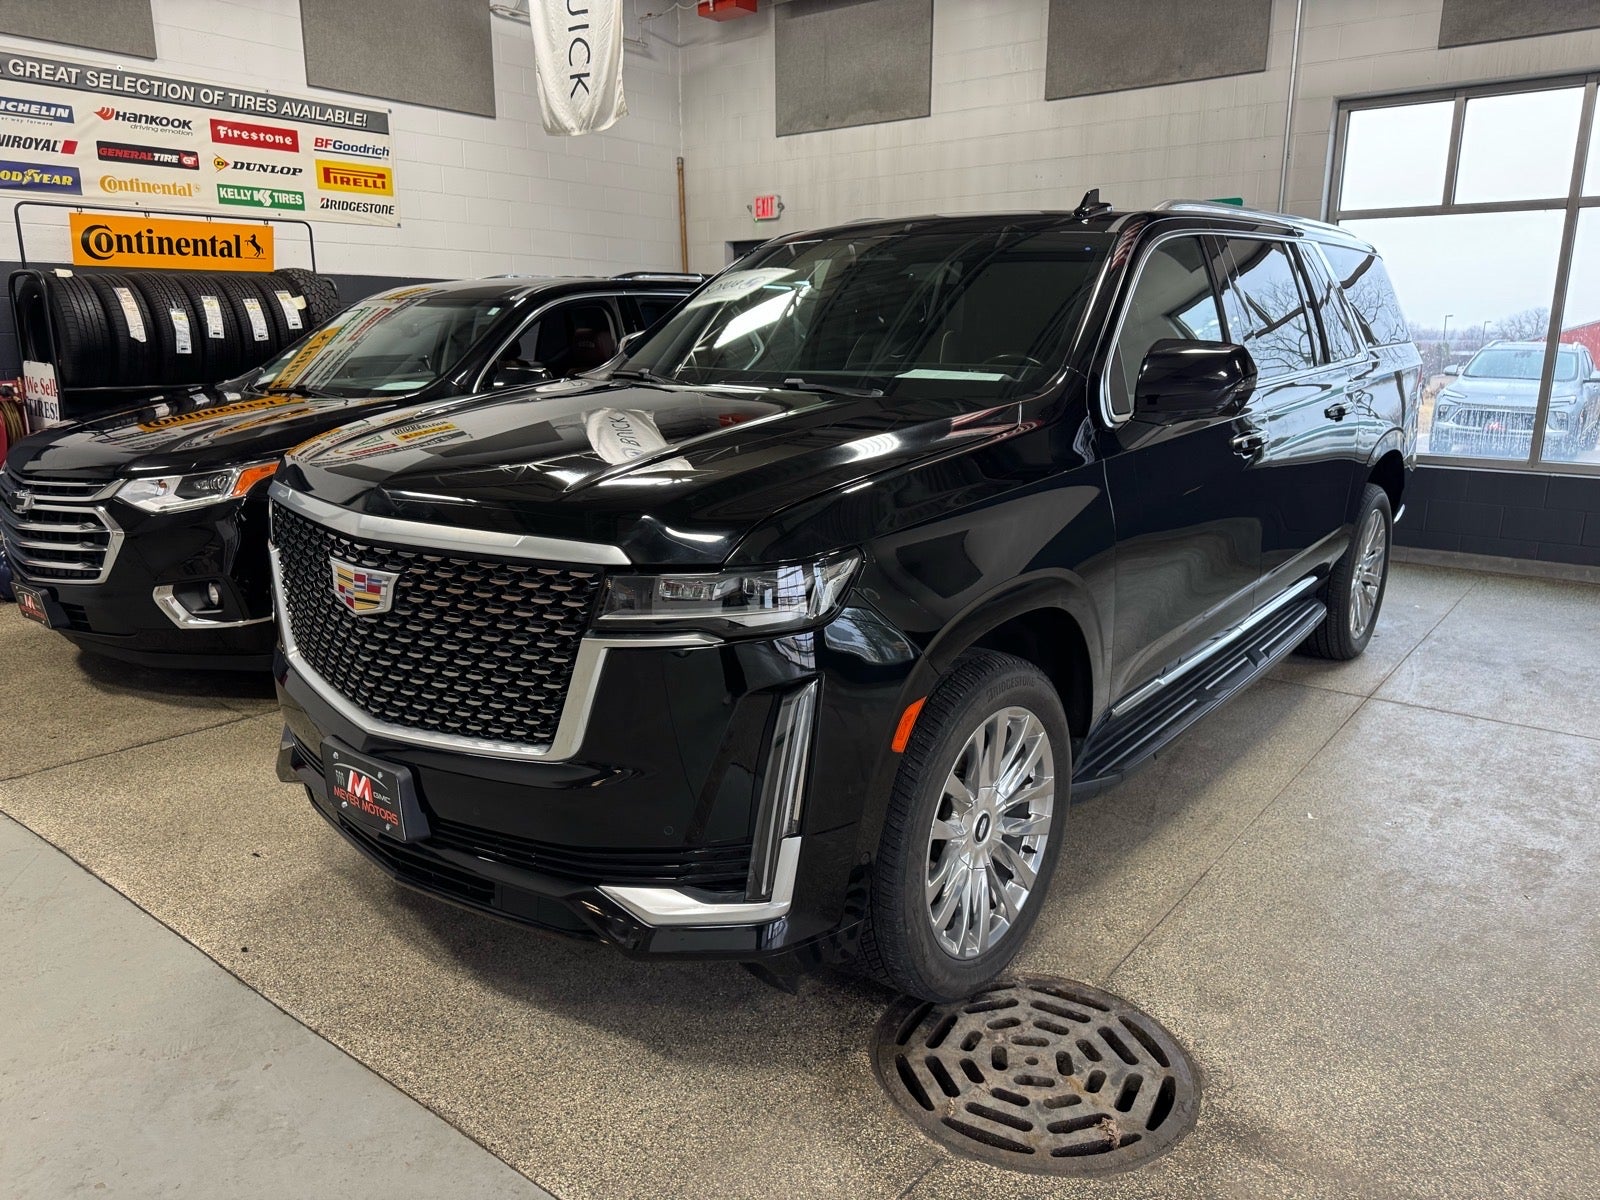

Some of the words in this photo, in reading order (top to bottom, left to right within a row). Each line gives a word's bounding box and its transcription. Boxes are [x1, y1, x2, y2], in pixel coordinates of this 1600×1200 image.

[8, 59, 81, 84] GREAT
[86, 70, 195, 101] SELECTION
[200, 88, 225, 105] OF
[228, 92, 277, 114] TIRES
[281, 101, 367, 127] AVAILABLE!
[130, 123, 159, 133] driving
[160, 128, 193, 137] emotion
[217, 125, 293, 145] Firestone
[314, 137, 390, 157] BFGoodrich
[231, 160, 303, 176] DUNLOP
[99, 174, 193, 197] Continental
[323, 167, 386, 190] PIRELLI
[219, 187, 252, 201] KELLY
[273, 191, 303, 205] TIRES
[320, 197, 395, 216] BRIDGESTONE
[755, 196, 775, 218] EXIT
[81, 224, 243, 261] Continental
[25, 375, 39, 394] We
[27, 398, 59, 420] TIRES!
[333, 785, 361, 809] MEYER
[361, 800, 399, 827] MOTORS
[373, 791, 392, 805] GMC
